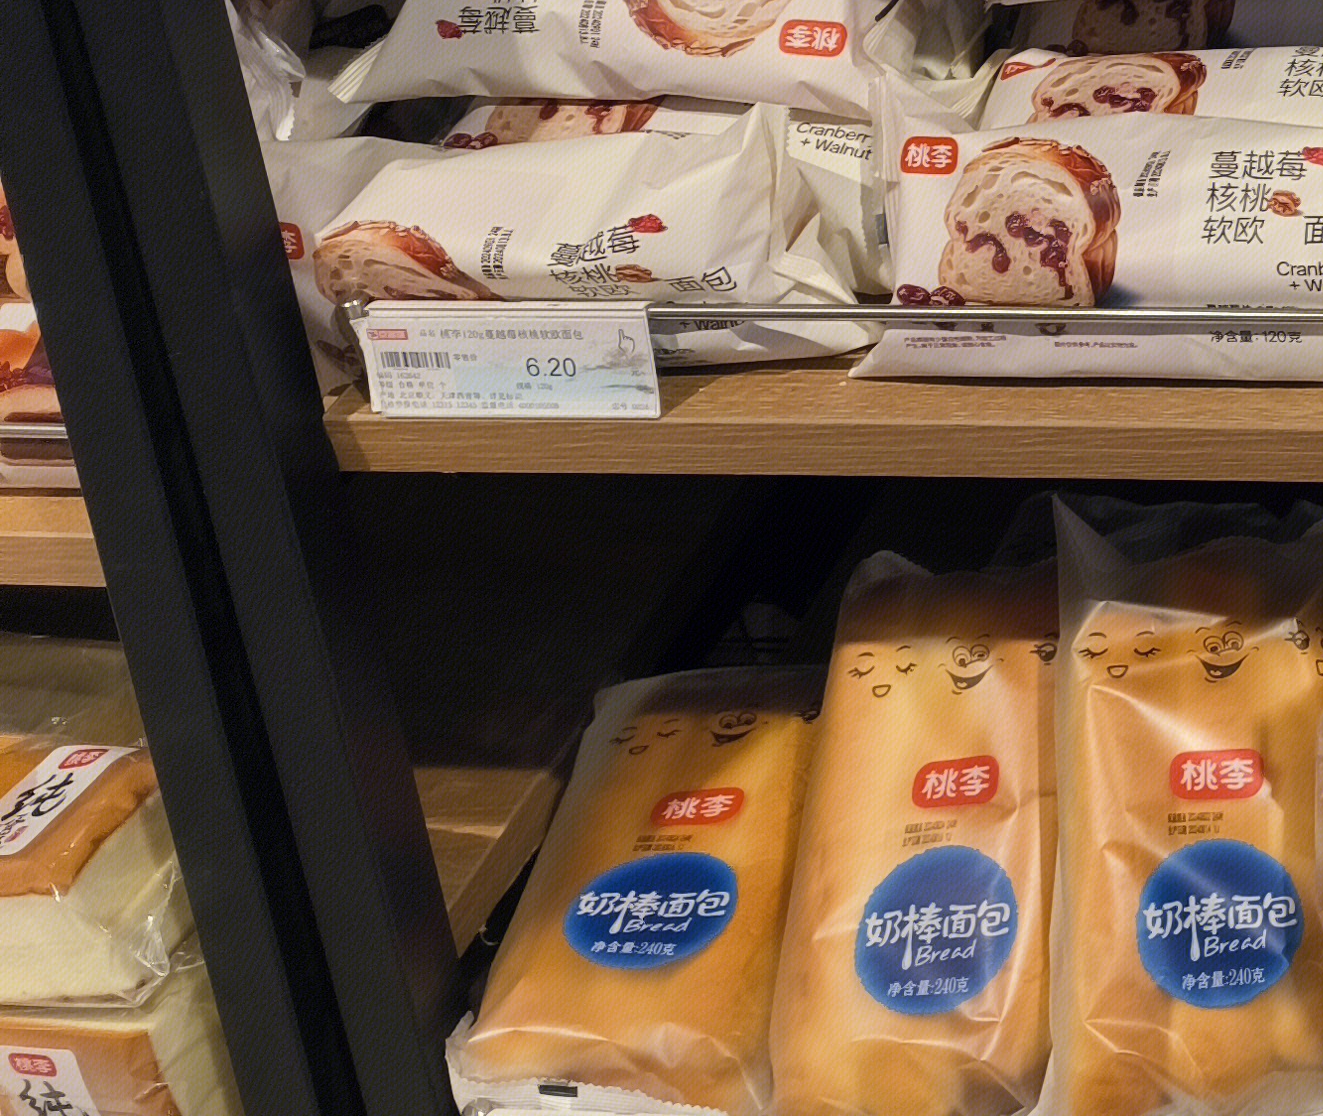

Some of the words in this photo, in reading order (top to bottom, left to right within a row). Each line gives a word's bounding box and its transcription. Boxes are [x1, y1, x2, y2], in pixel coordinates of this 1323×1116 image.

[814, 138, 873, 162] Walnut
[906, 141, 954, 169] 桃李
[1208, 150, 1308, 181] 蔓越莓
[1205, 182, 1272, 213] 核桃
[1200, 216, 1265, 245] 软欧
[665, 266, 738, 294] 面包
[1209, 329, 1303, 344] 净含量:120克
[526, 356, 577, 377] 6.20
[923, 764, 991, 800] 桃李
[1179, 758, 1255, 793] 桃李
[661, 793, 735, 821] 桃李
[576, 889, 731, 934] 奶棒面包
[622, 917, 690, 933] Bread
[865, 893, 1012, 971] 奶棒面包
[1142, 892, 1299, 964] 奶棒面包
[590, 940, 677, 957] 净含量:240克
[914, 938, 977, 967] Bread
[1203, 929, 1268, 960] Bread
[887, 975, 971, 998] 净含量:240克
[1181, 965, 1266, 992] 净含量:240克
